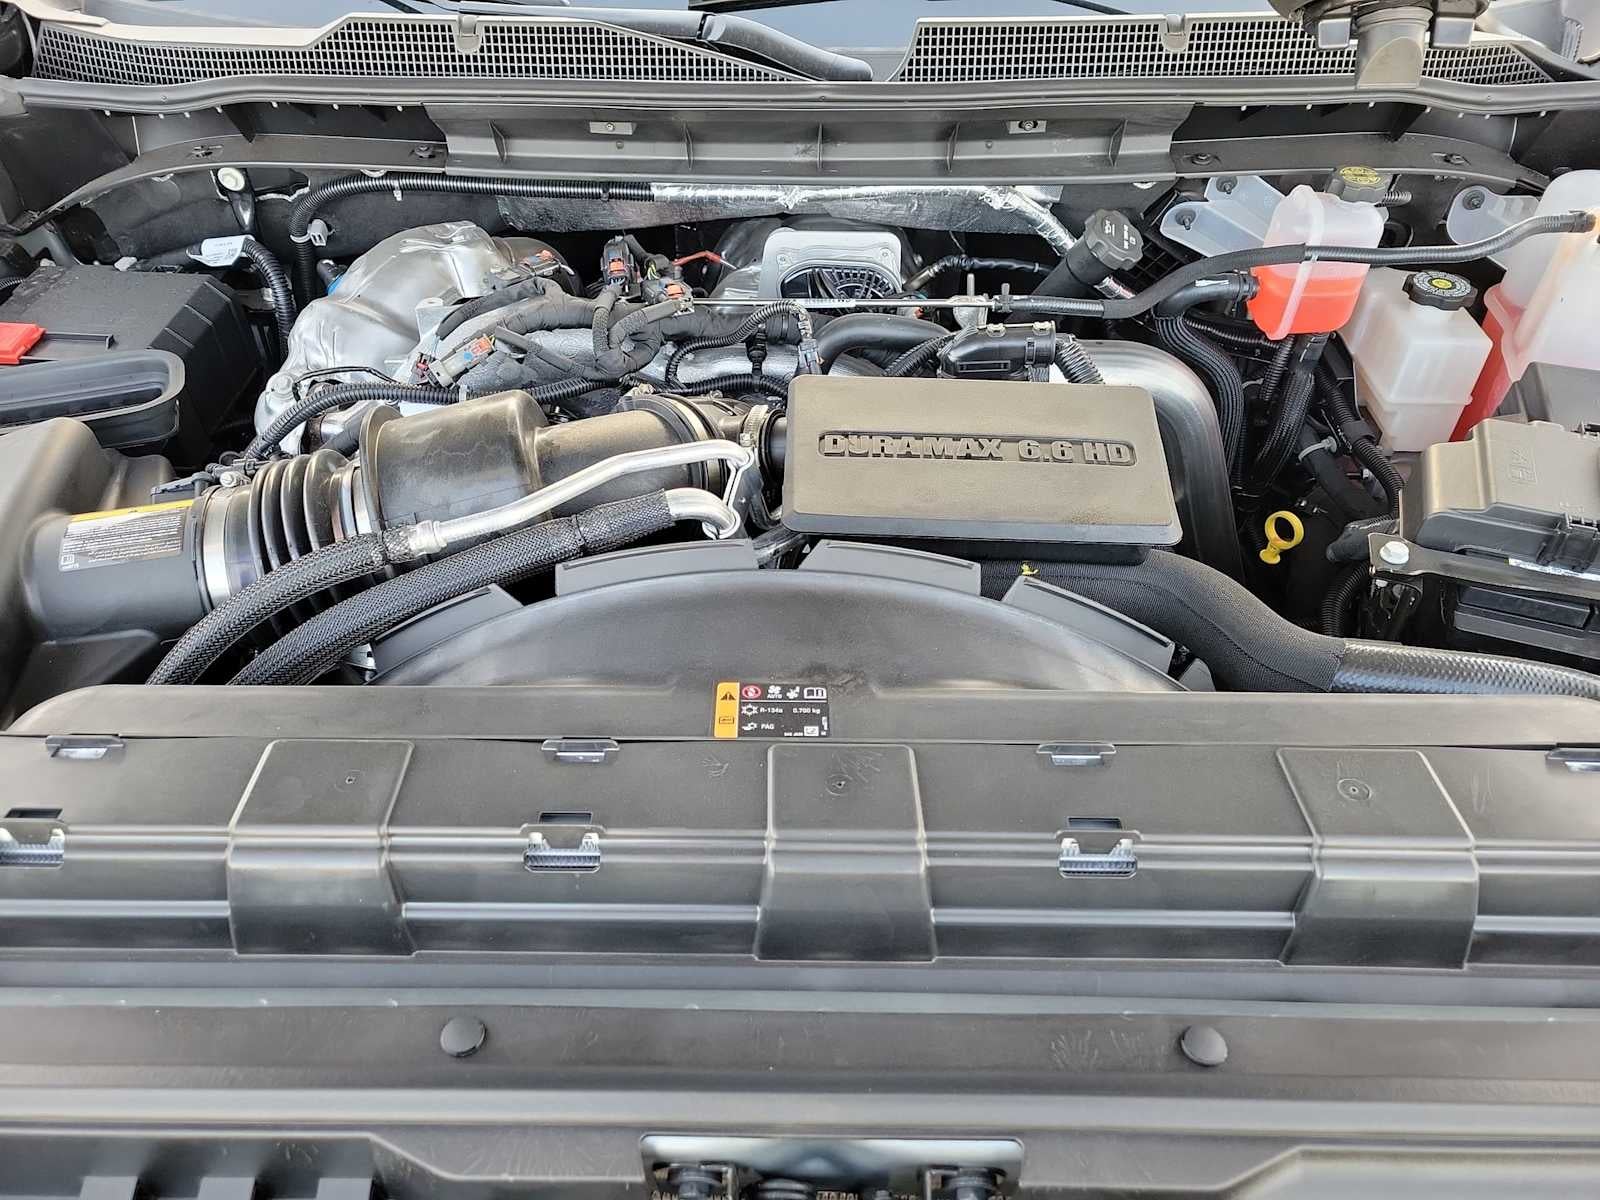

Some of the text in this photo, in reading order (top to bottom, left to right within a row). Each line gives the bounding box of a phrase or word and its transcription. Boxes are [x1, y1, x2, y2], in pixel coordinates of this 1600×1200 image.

[823, 434, 1132, 465] DURAMAX 6.6 HD
